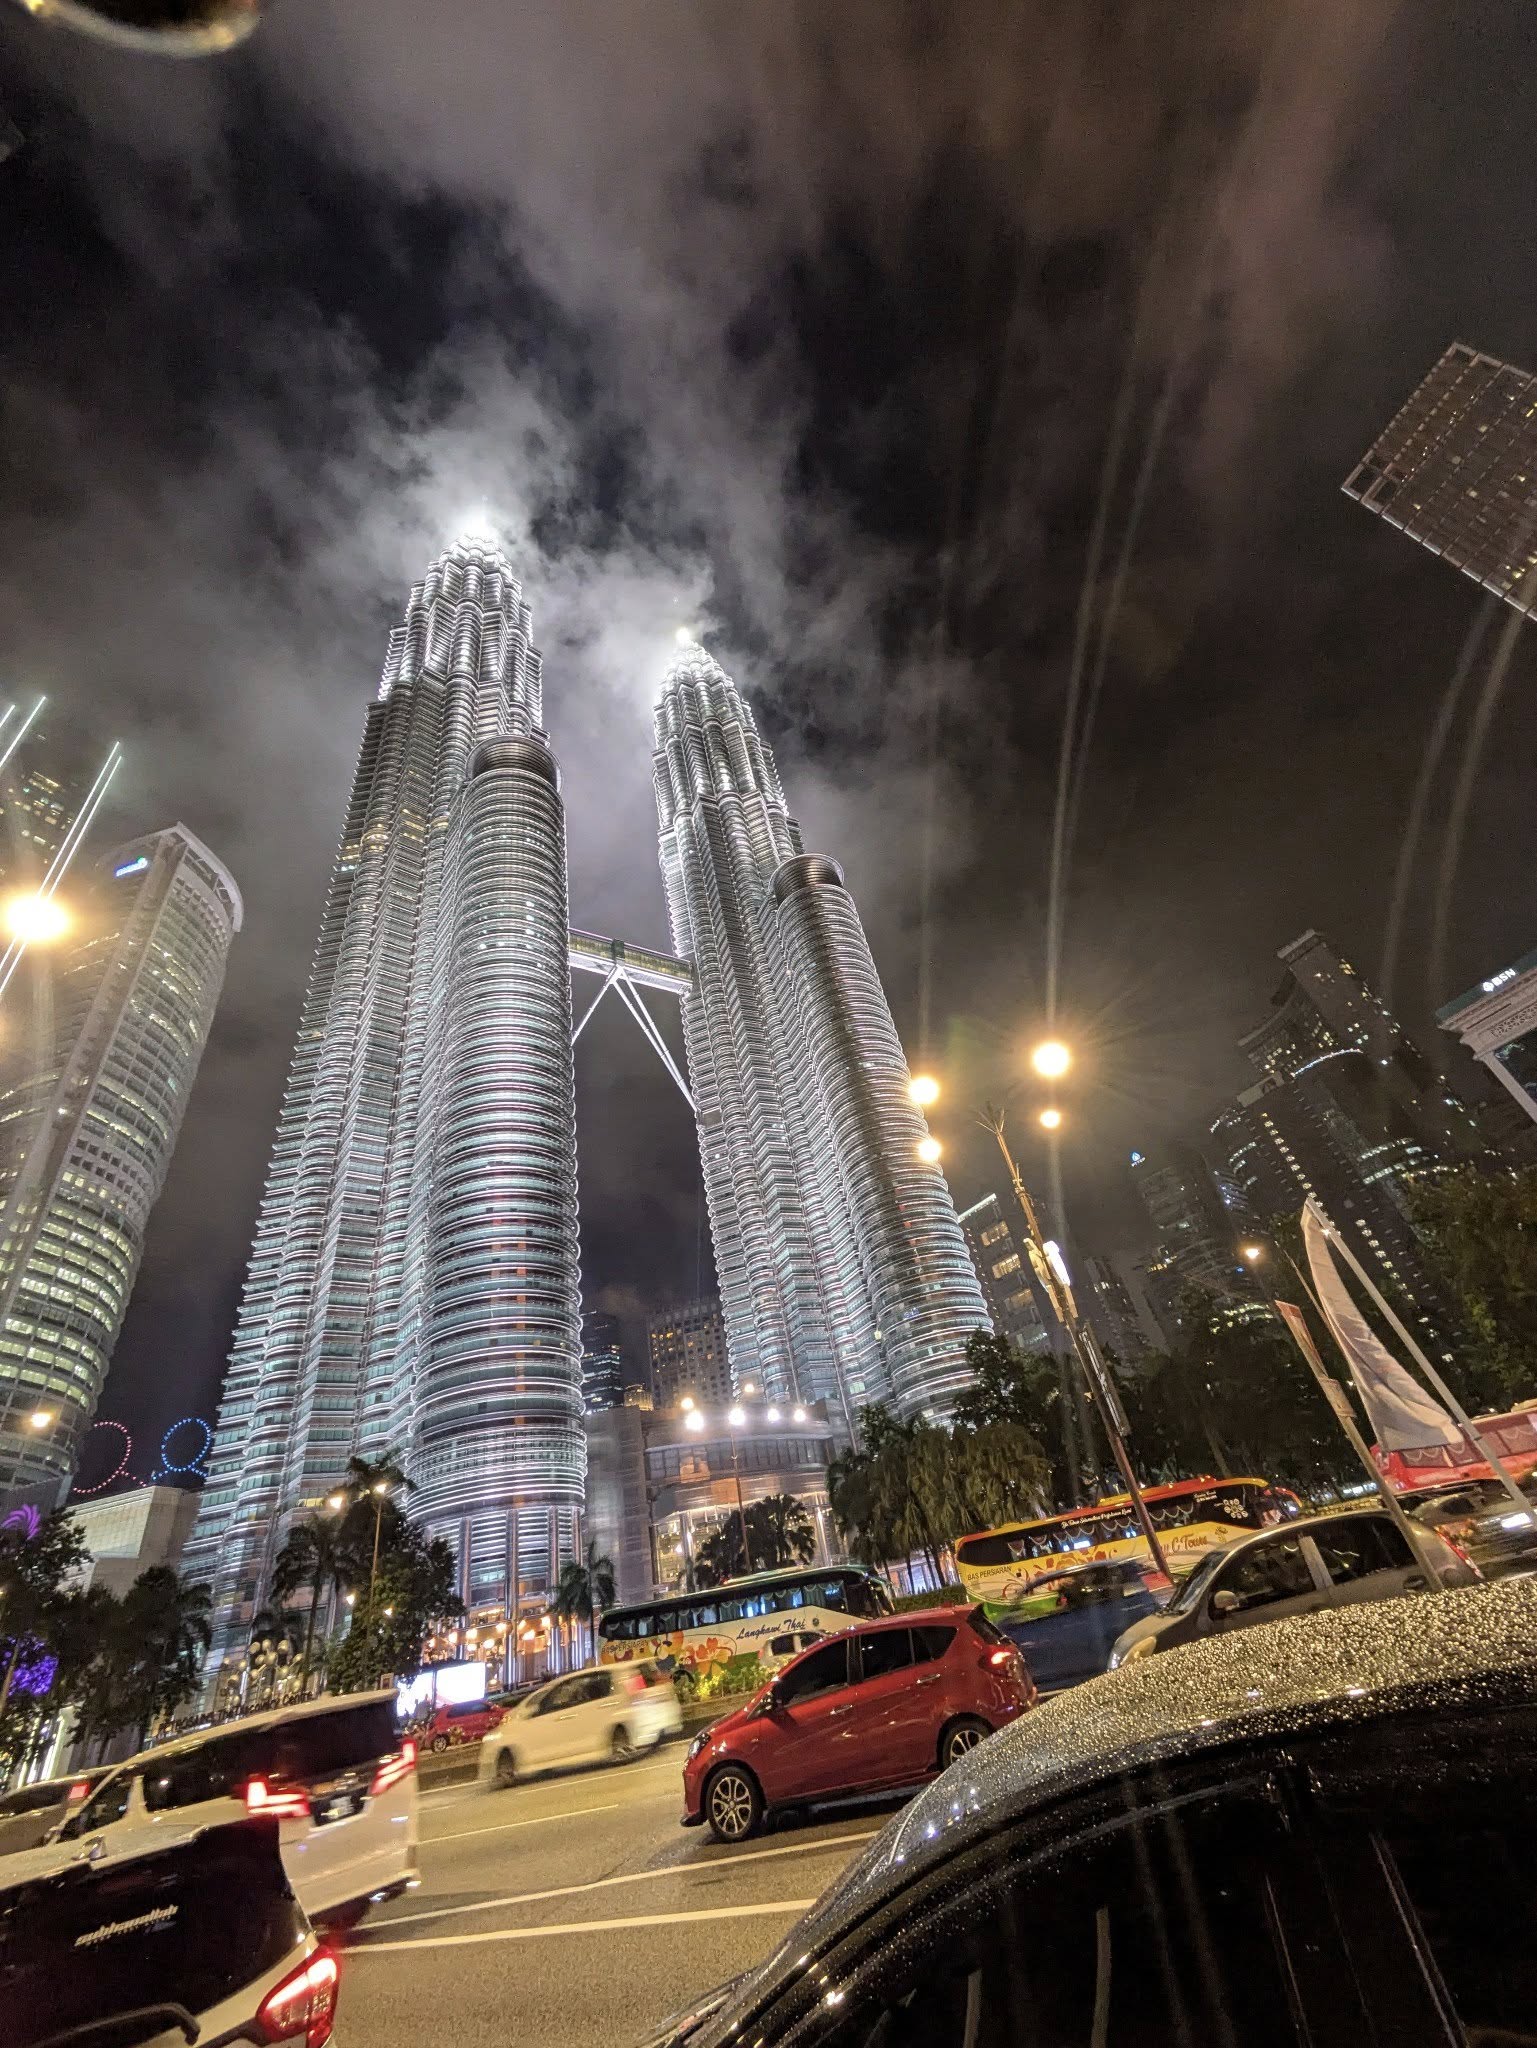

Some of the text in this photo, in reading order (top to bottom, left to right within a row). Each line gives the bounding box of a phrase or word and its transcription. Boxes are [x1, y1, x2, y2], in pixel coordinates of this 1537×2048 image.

[1491, 968, 1516, 986] BSN
[967, 1565, 1012, 1581] BAS PERSIARAN
[736, 1618, 806, 1640] Langkawi Thai
